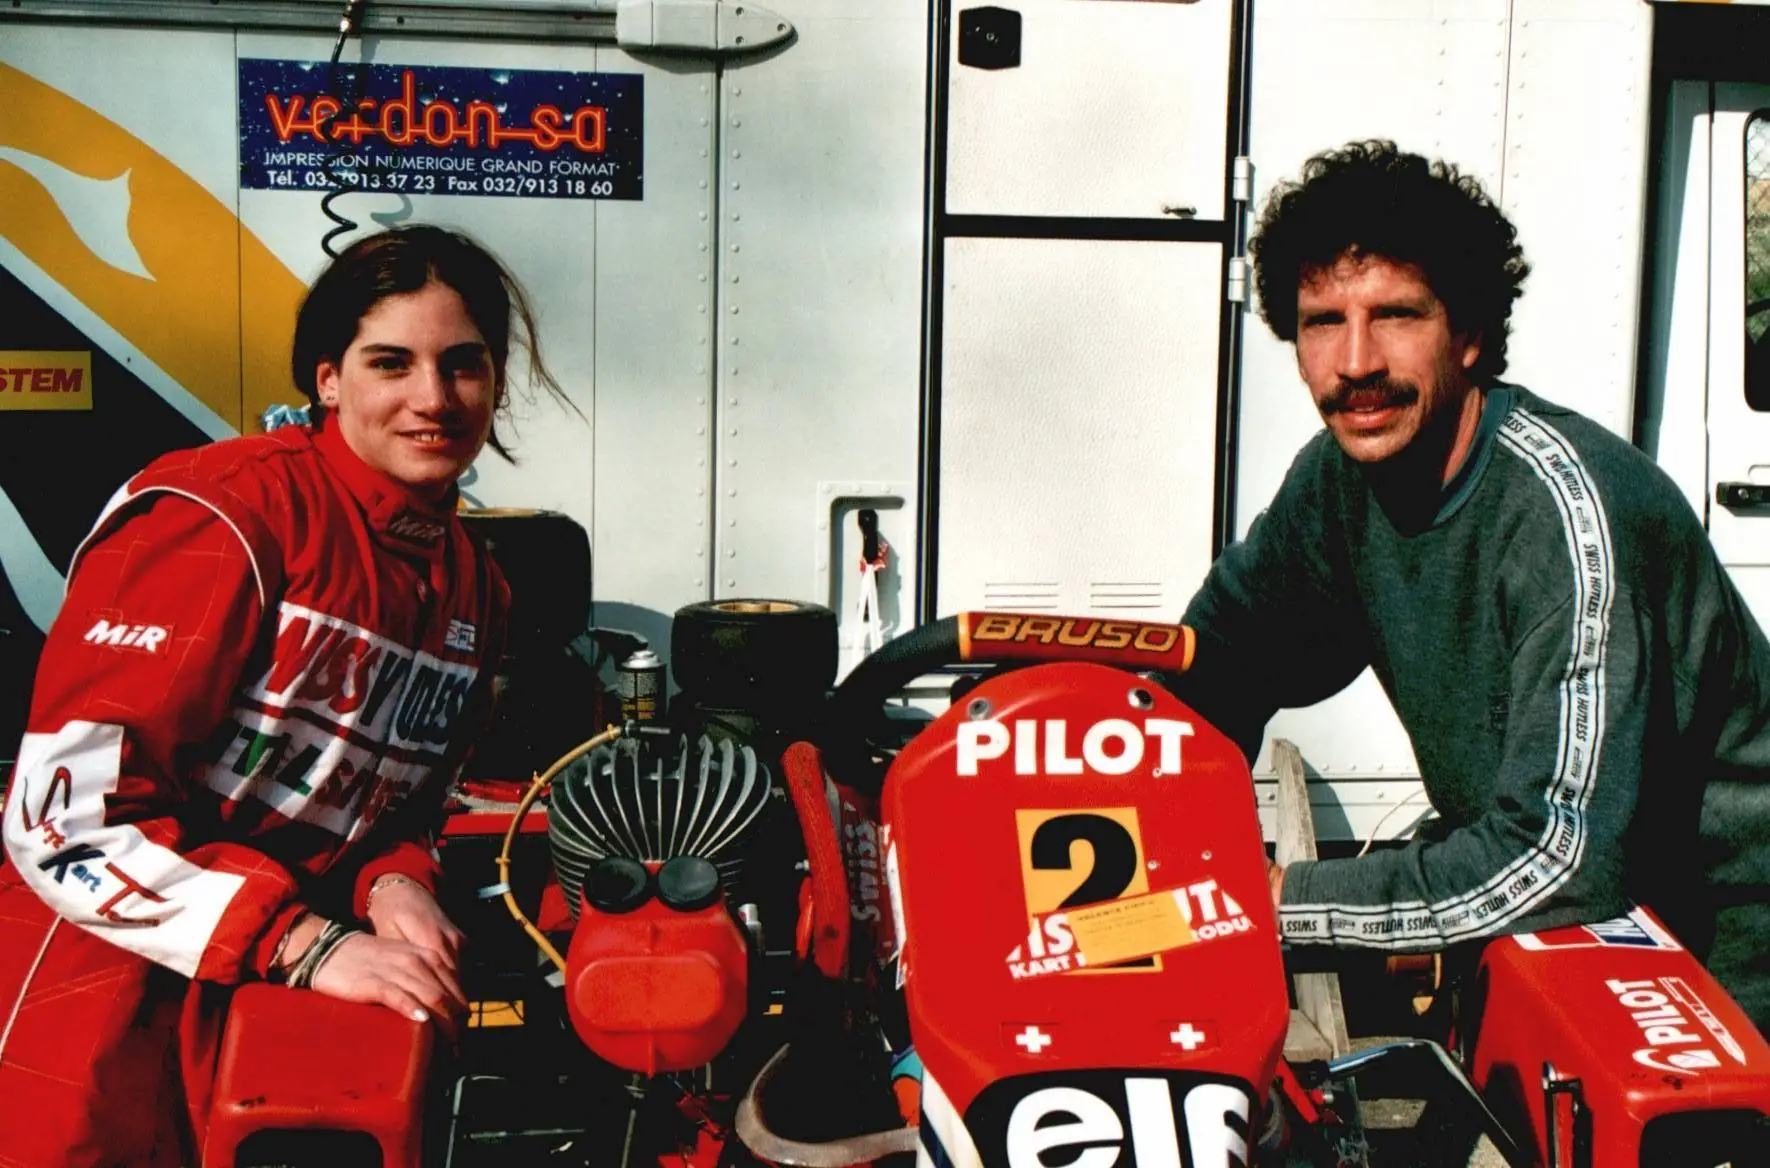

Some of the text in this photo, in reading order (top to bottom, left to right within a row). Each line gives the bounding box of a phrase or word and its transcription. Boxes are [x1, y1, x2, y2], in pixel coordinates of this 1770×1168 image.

[265, 69, 606, 152] verdon sa
[267, 170, 297, 186] Tél.
[388, 174, 406, 191] 37
[413, 174, 436, 191] 23
[448, 176, 478, 192] Fax
[483, 178, 558, 196] 032/913
[566, 179, 586, 195] 18
[591, 180, 614, 196] 60
[374, 154, 475, 172] NUMERIQUE
[480, 158, 544, 175] GRAND
[549, 159, 615, 177] FORMAT
[1583, 543, 1602, 620] SWISS HUTLESS
[972, 614, 1179, 653] BRUSO
[1575, 697, 1590, 742] HUTLESS
[956, 718, 1196, 777] PILOT
[38, 842, 107, 893] Kart
[1030, 812, 1155, 968] 2
[1508, 869, 1540, 900] SWISS
[1286, 918, 1318, 934] SWISS
[1361, 912, 1440, 934] SWISS HUTLESS
[1008, 954, 1072, 980] KART
[1604, 978, 1702, 1046] PILOT
[1005, 1076, 1250, 1168] elf
